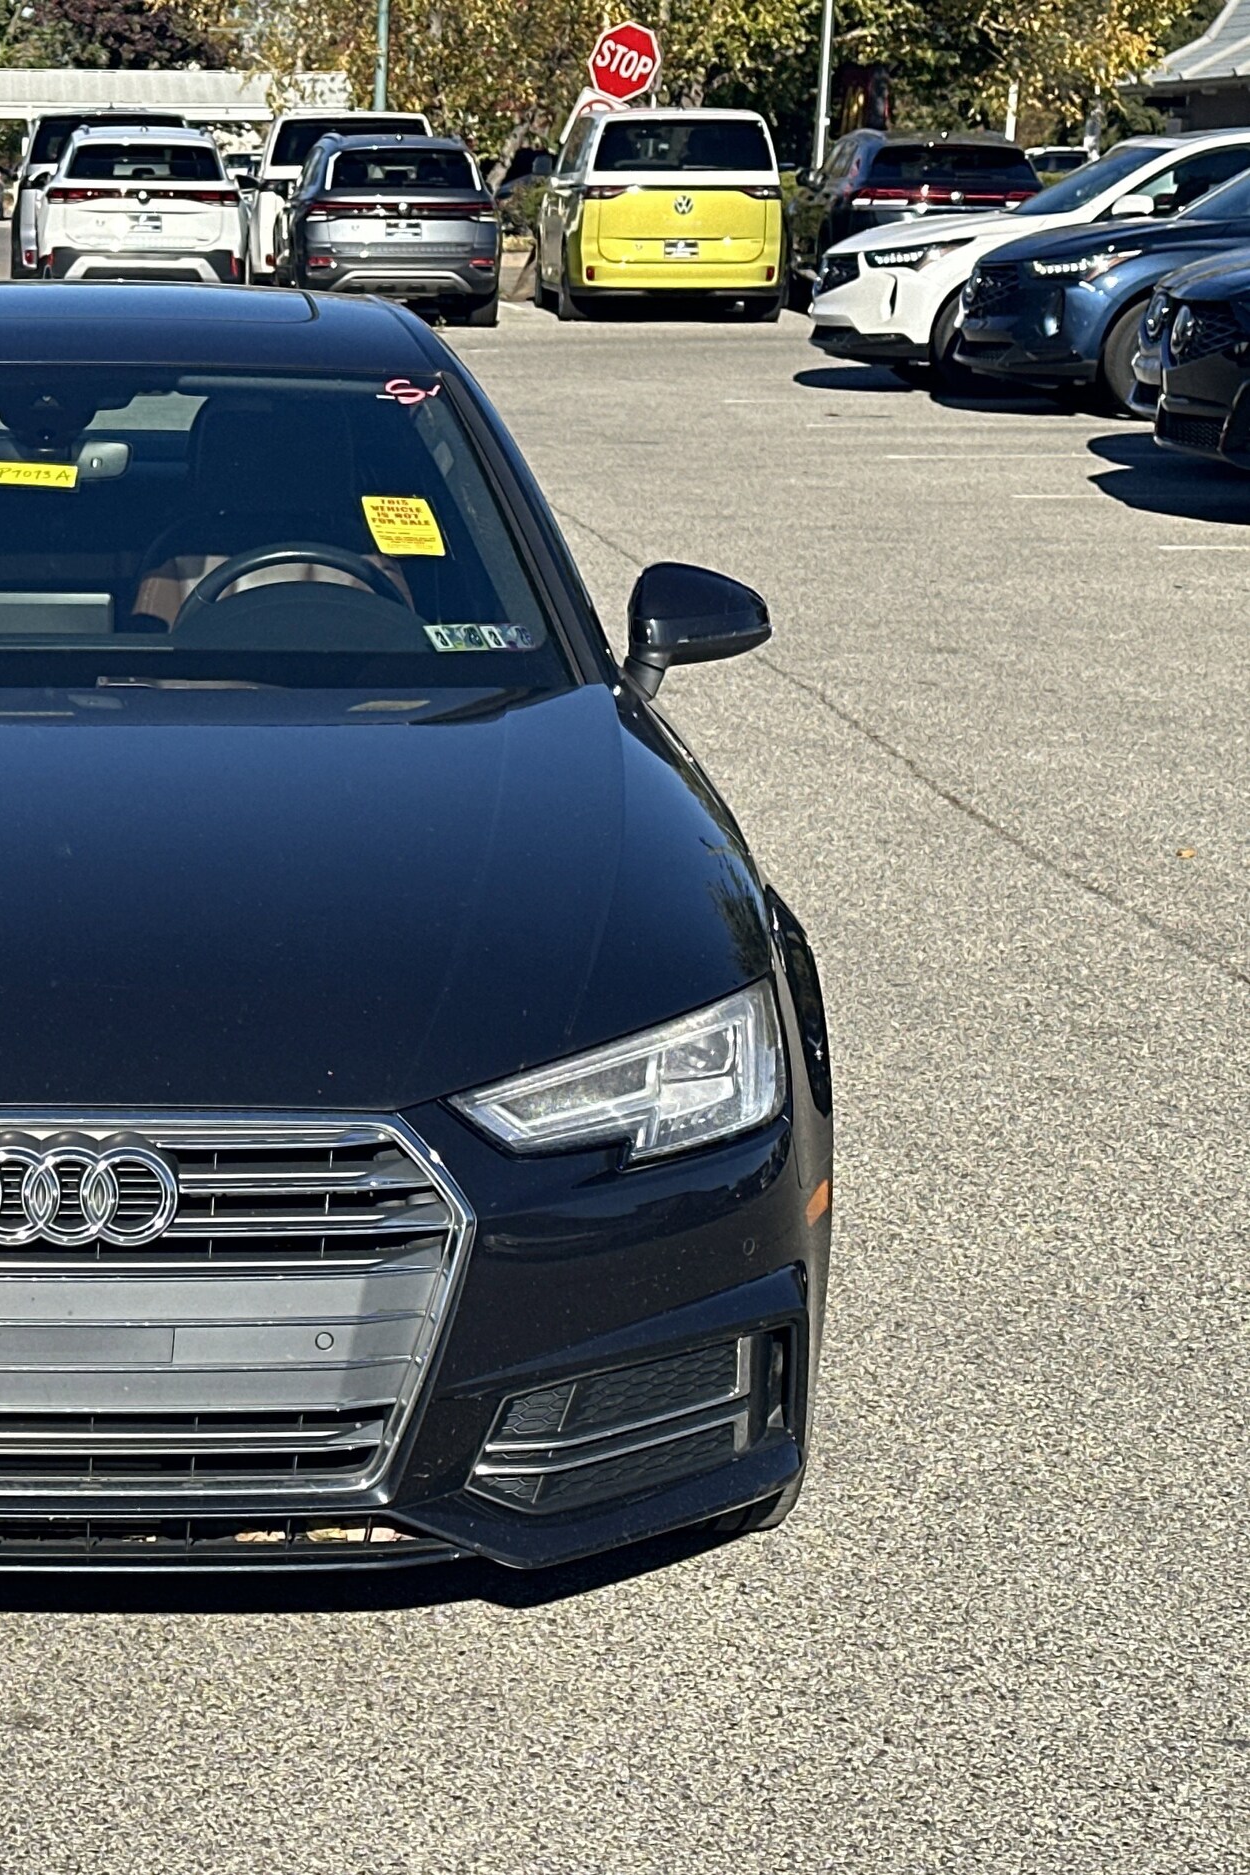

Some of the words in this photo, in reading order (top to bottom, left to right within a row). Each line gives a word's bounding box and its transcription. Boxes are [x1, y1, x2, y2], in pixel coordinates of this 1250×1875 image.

[595, 40, 653, 82] STOP
[370, 505, 423, 513] VEHICLE
[371, 517, 396, 525] FOR
